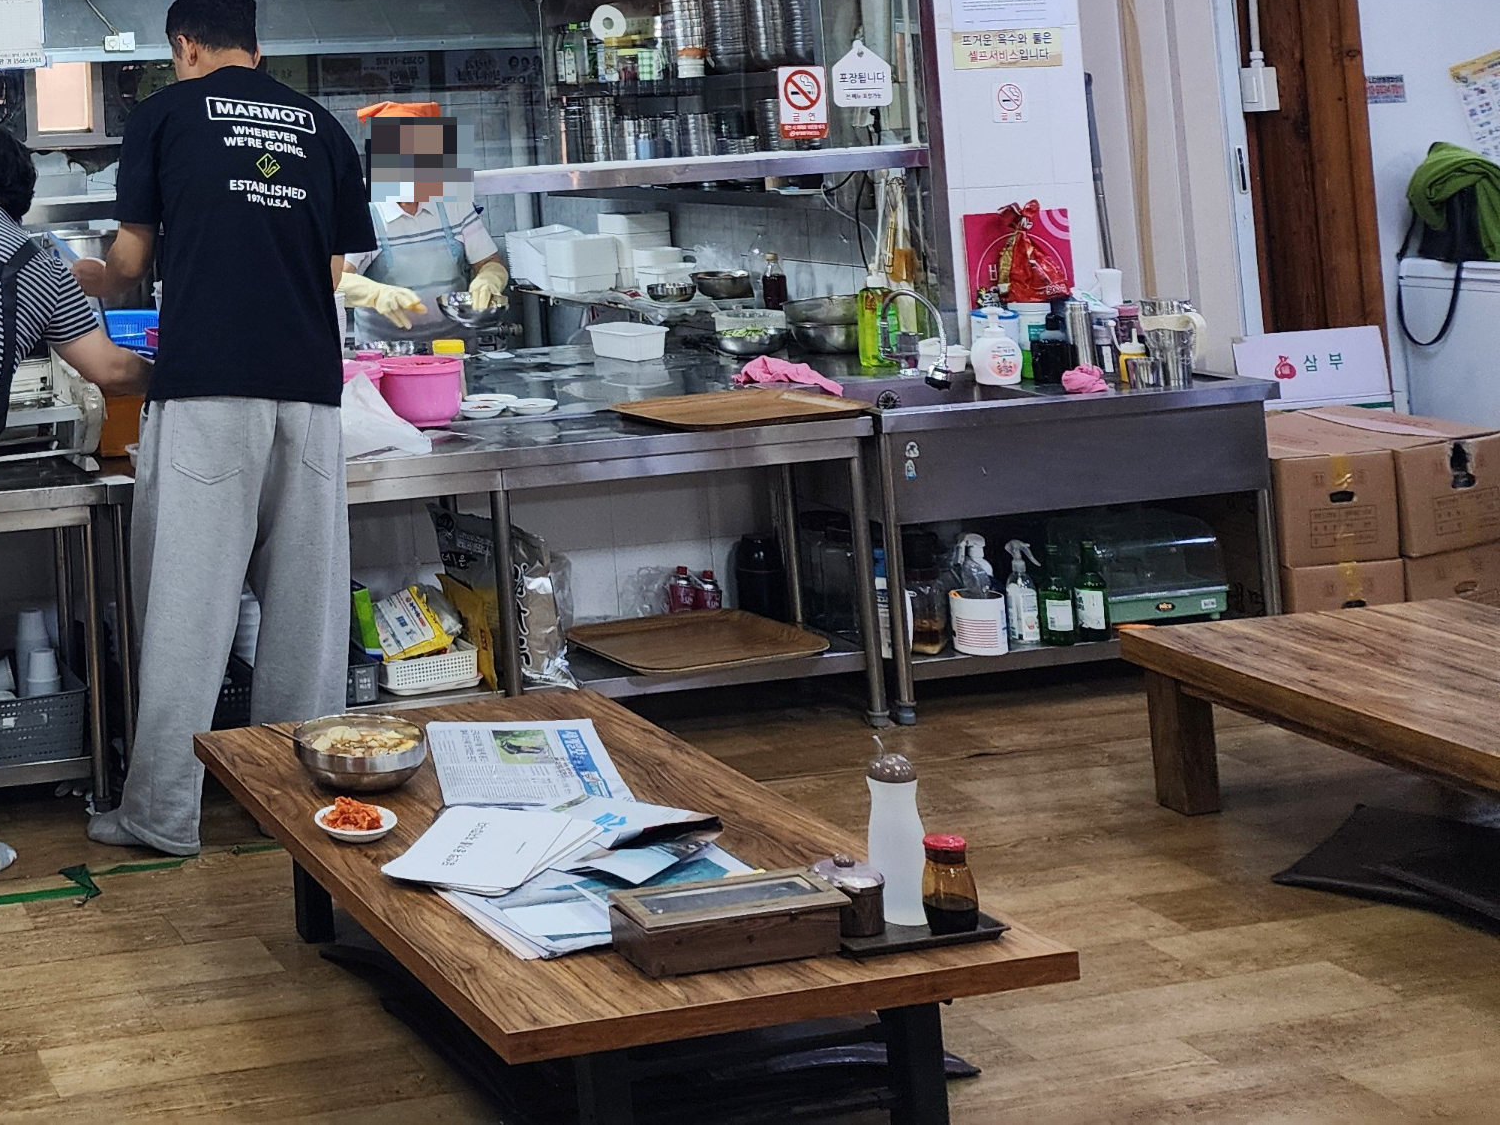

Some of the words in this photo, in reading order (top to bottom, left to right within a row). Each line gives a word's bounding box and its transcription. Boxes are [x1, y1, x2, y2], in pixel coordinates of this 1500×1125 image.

[962, 34, 992, 47] 뜨거운
[998, 33, 1028, 45] 육수와
[1032, 31, 1053, 45] 물은
[968, 48, 1049, 63] 셀프서비스입니다
[839, 71, 886, 84] 포장됩니다
[216, 101, 306, 125] MARMOT
[232, 125, 298, 144] WHEREVER
[224, 137, 263, 149] WE'RE
[265, 141, 307, 159] GOING.
[230, 179, 307, 200] ESTABLISHED
